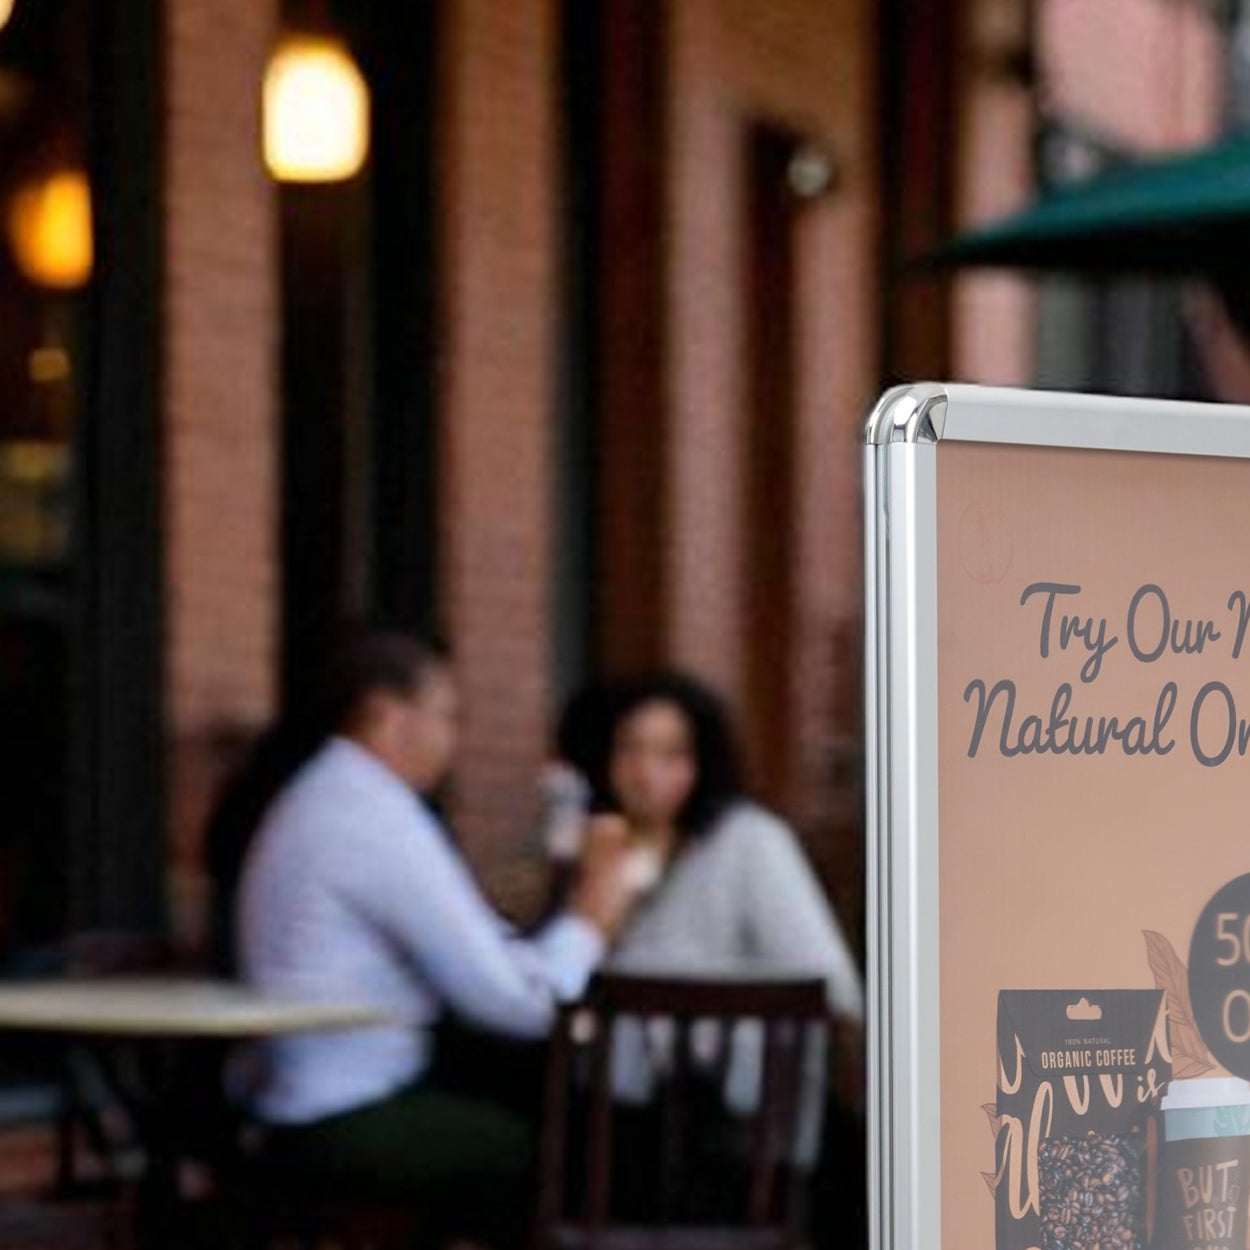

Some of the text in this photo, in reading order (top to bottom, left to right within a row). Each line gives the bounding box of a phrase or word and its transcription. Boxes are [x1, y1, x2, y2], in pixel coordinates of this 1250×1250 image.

[1020, 582, 1118, 683] Try
[1127, 584, 1221, 662] Our
[963, 679, 1178, 758] Natural
[1041, 1049, 1136, 1069] ORGANIC COFFEE
[1177, 1160, 1239, 1208] BUT
[1183, 1206, 1237, 1240] FIRST
